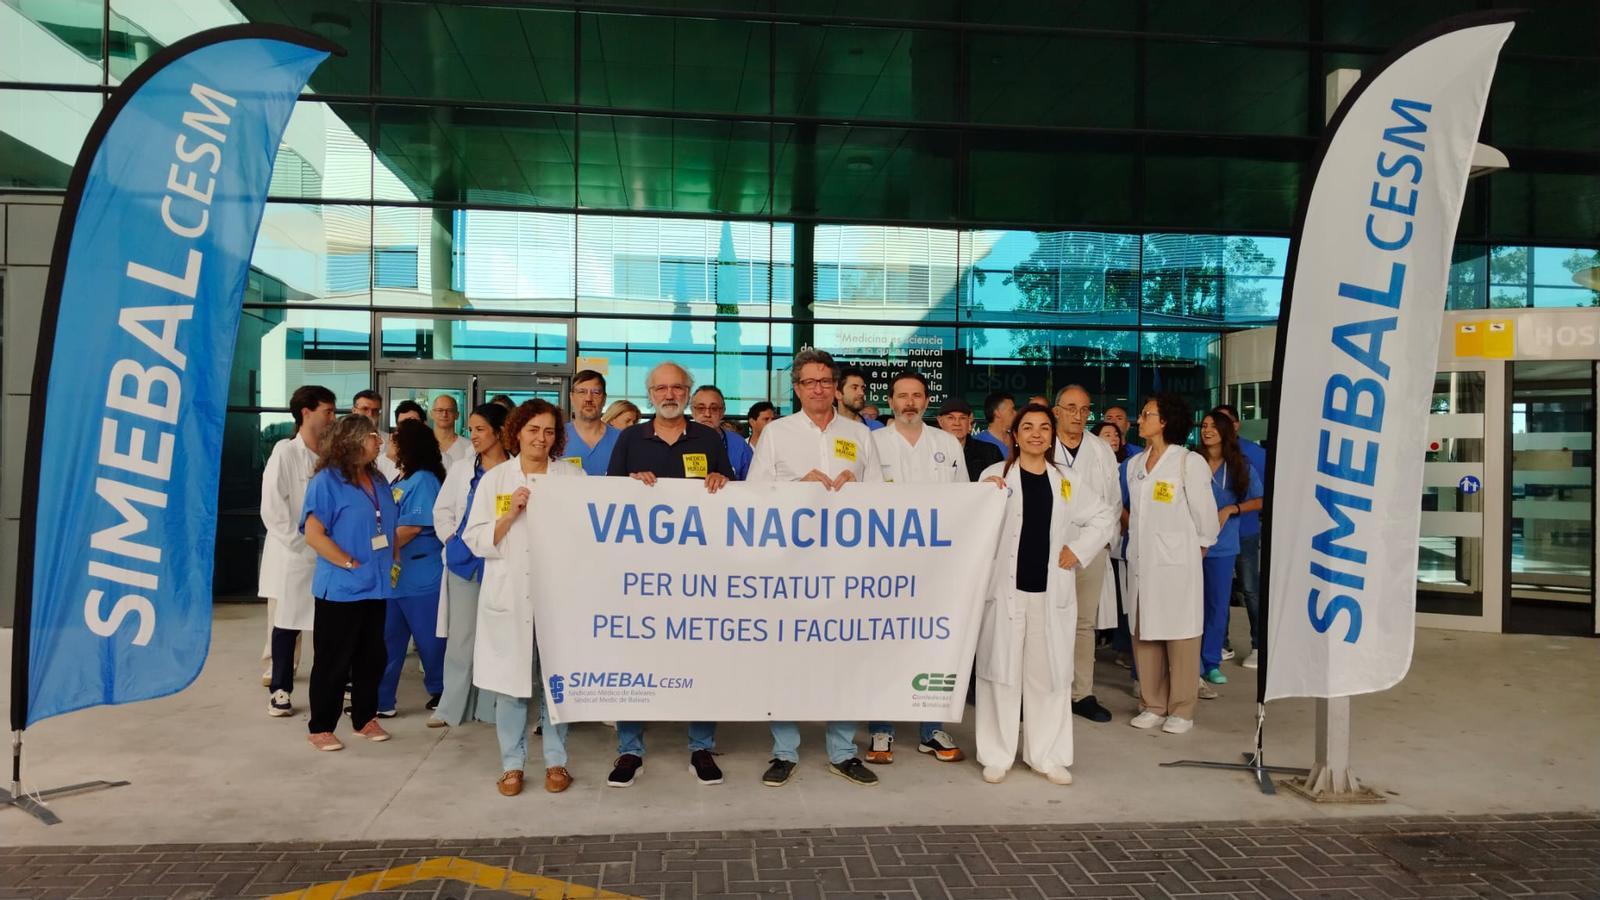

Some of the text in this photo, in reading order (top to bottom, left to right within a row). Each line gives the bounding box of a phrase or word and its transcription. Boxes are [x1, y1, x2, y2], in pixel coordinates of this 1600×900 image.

[84, 83, 238, 646] SIMEBAL CESM
[859, 359, 908, 368] conservar
[911, 358, 943, 368] natura
[909, 347, 943, 357] natural
[1307, 98, 1432, 644] SIMEBAL CESM
[587, 502, 953, 549] VAGA NACIONAL
[623, 572, 916, 599] PER UN ESTATUT PROPI
[592, 614, 951, 642] PELS METGES I FACULTATIUS
[568, 672, 694, 690] SIMEBAL CESM
